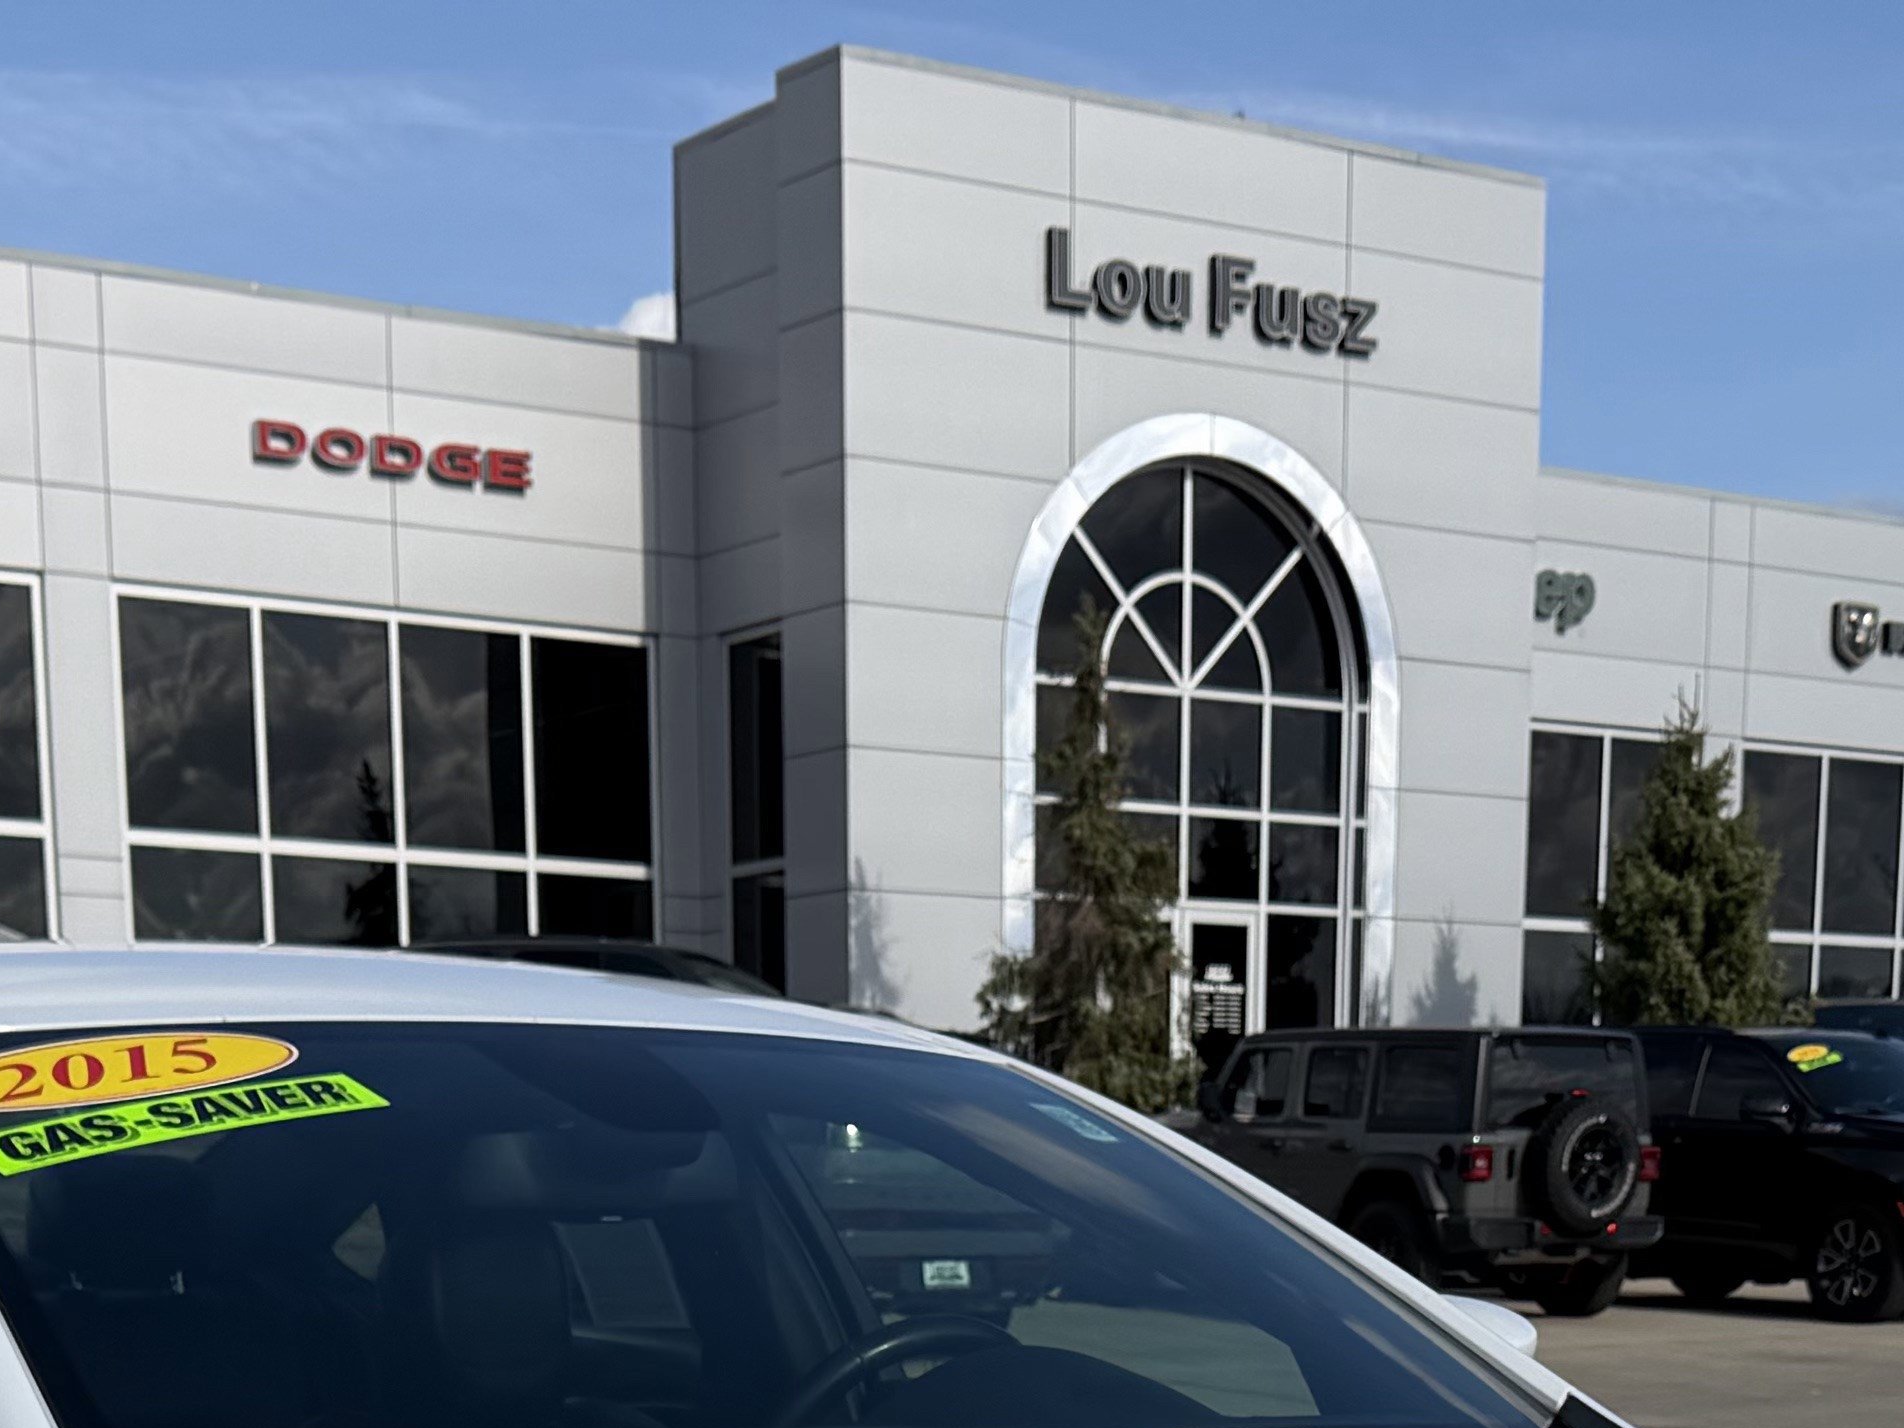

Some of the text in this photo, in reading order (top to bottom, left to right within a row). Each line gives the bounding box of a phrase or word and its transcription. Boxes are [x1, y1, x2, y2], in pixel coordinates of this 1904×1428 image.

[1045, 224, 1378, 362] Lou Fusz
[251, 417, 535, 497] DODGE
[1534, 569, 1596, 637] ep
